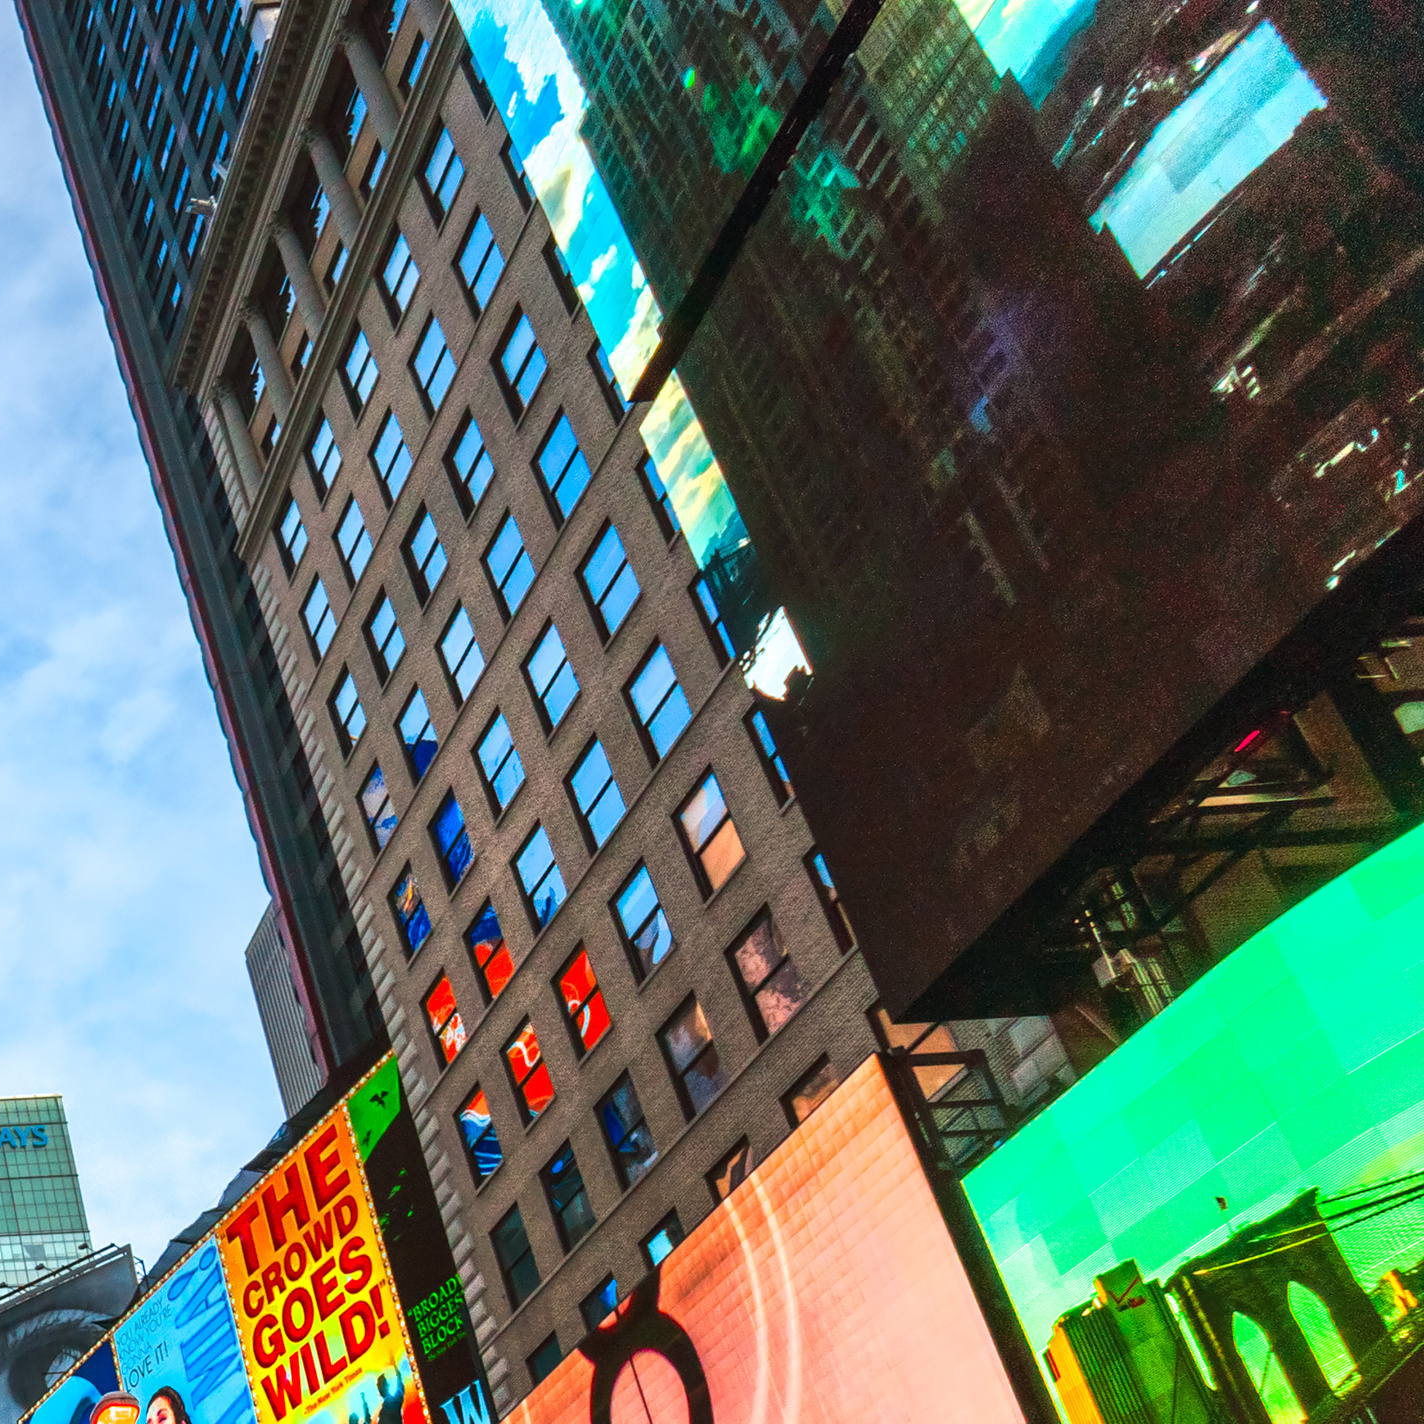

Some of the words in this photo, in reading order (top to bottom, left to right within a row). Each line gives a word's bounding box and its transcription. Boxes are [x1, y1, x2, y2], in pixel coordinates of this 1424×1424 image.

[241, 1195, 360, 1315] CROWD
[134, 1297, 164, 1336] ALREADY
[144, 1303, 172, 1343] YOU'RE
[251, 1235, 374, 1368] GOES
[120, 1341, 152, 1376] GONNA
[123, 1354, 155, 1394] LOVE
[155, 1341, 169, 1369] IT!
